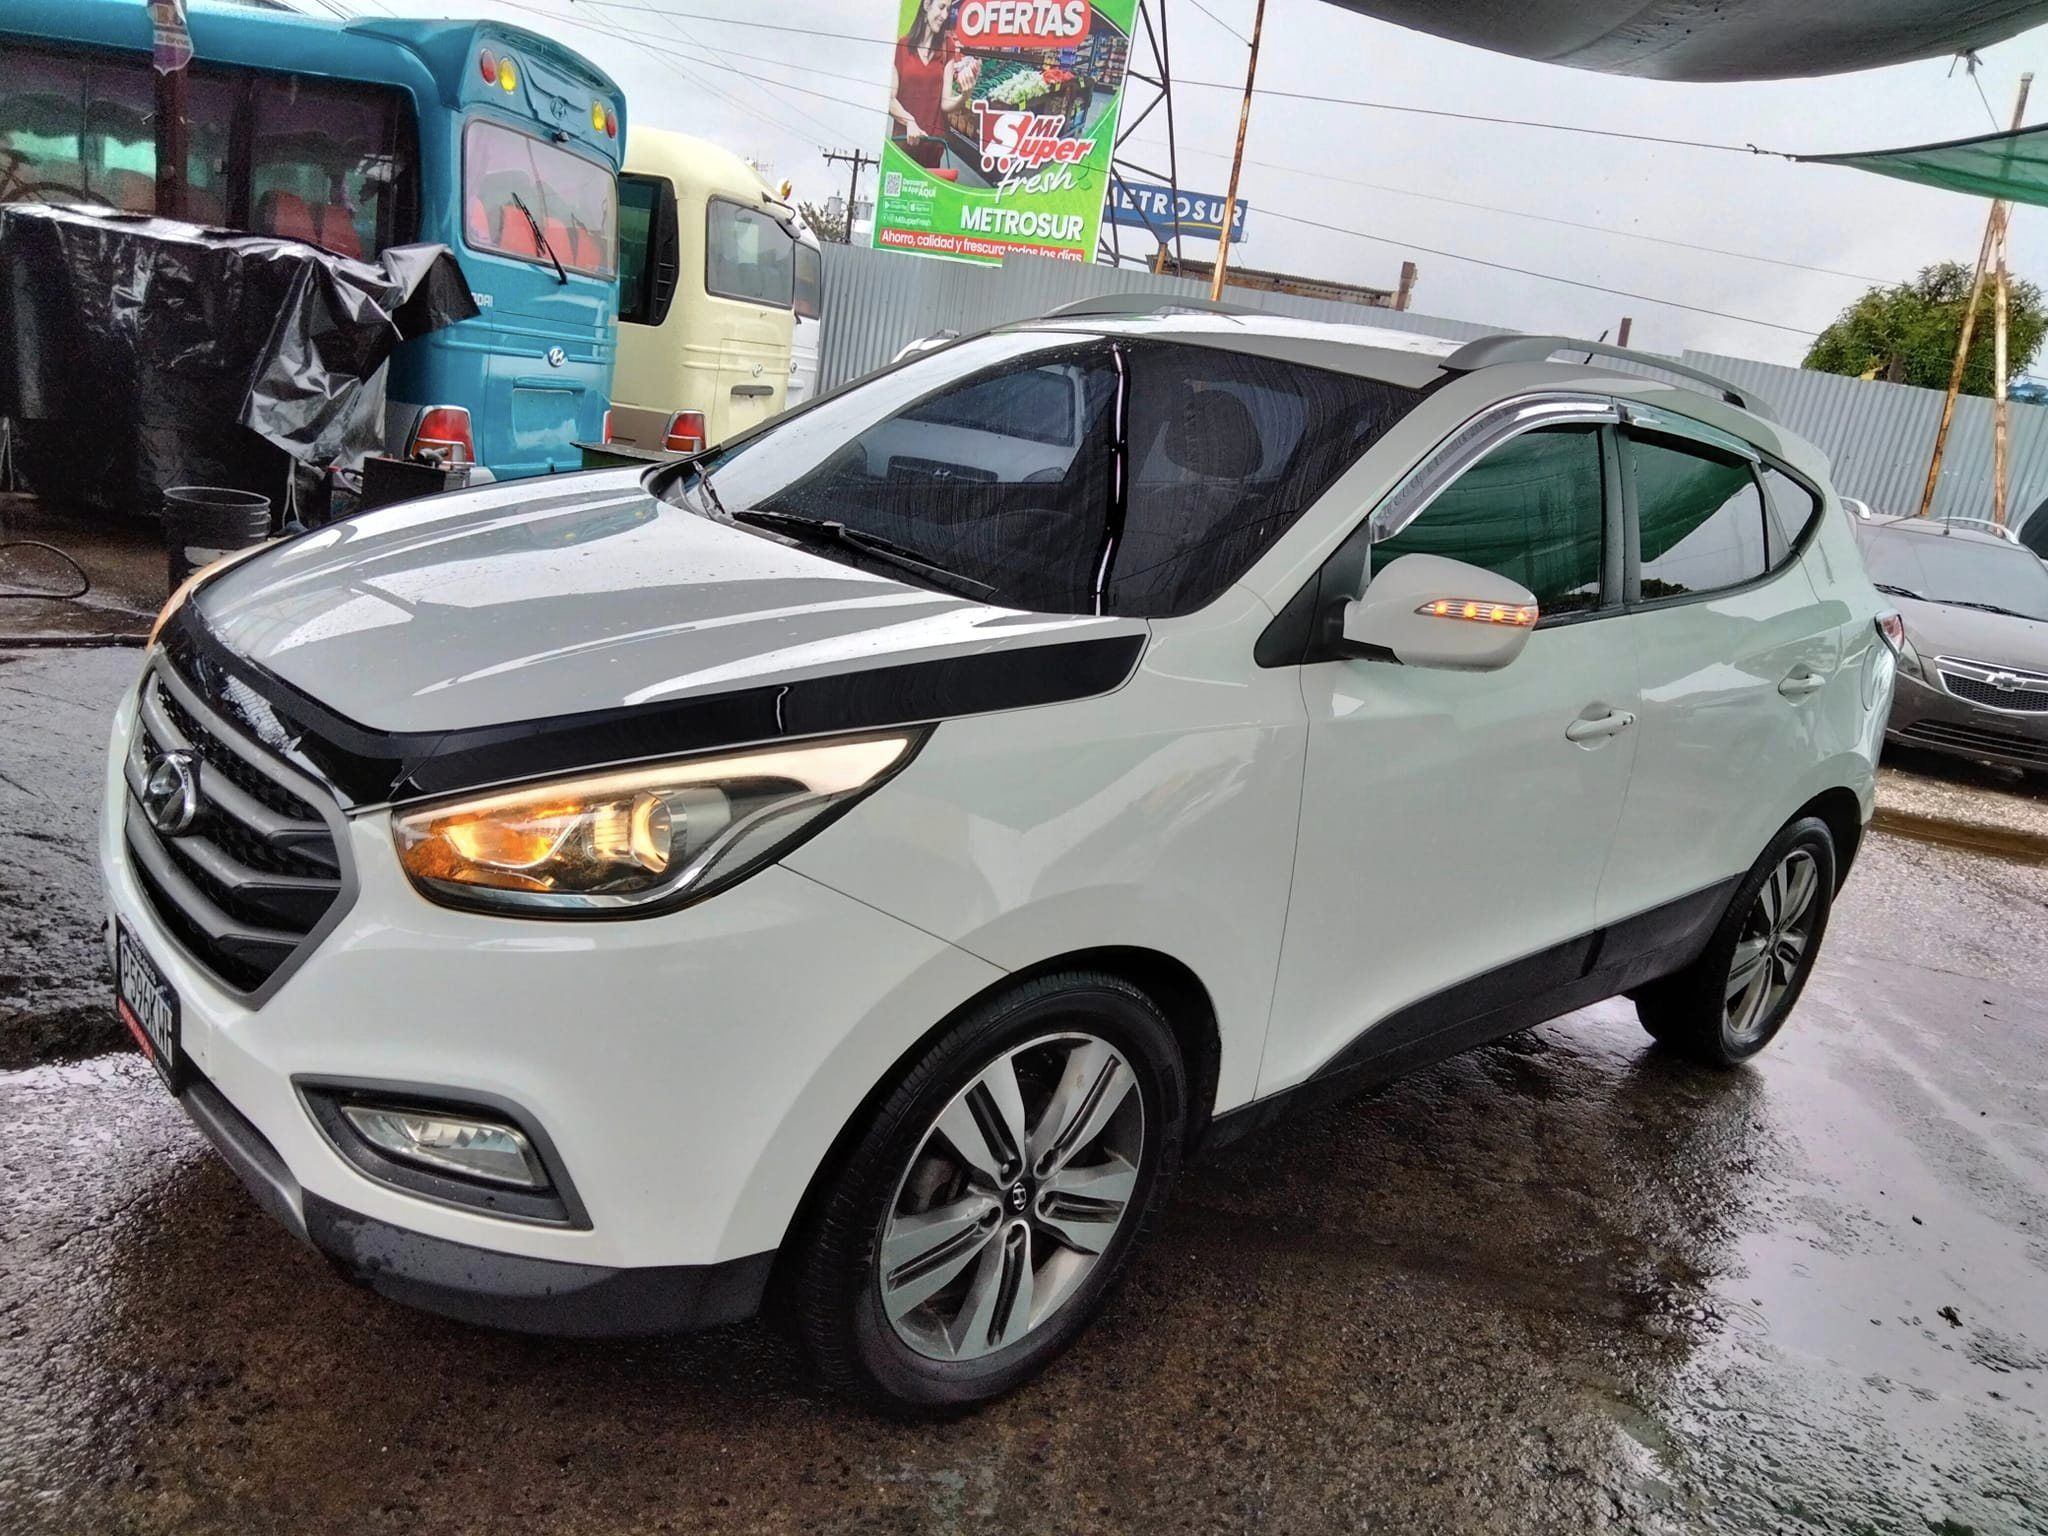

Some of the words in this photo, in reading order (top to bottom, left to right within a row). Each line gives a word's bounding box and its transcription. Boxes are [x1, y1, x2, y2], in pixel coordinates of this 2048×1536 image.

[961, 0, 1085, 36] OFERTAS
[1028, 117, 1063, 138] Mi
[995, 160, 1078, 203] fresh
[960, 204, 1084, 241] METROSUR
[881, 230, 916, 247] Ahorro,
[916, 234, 955, 250] calidad
[955, 240, 963, 254] y
[963, 238, 1005, 256] frescura
